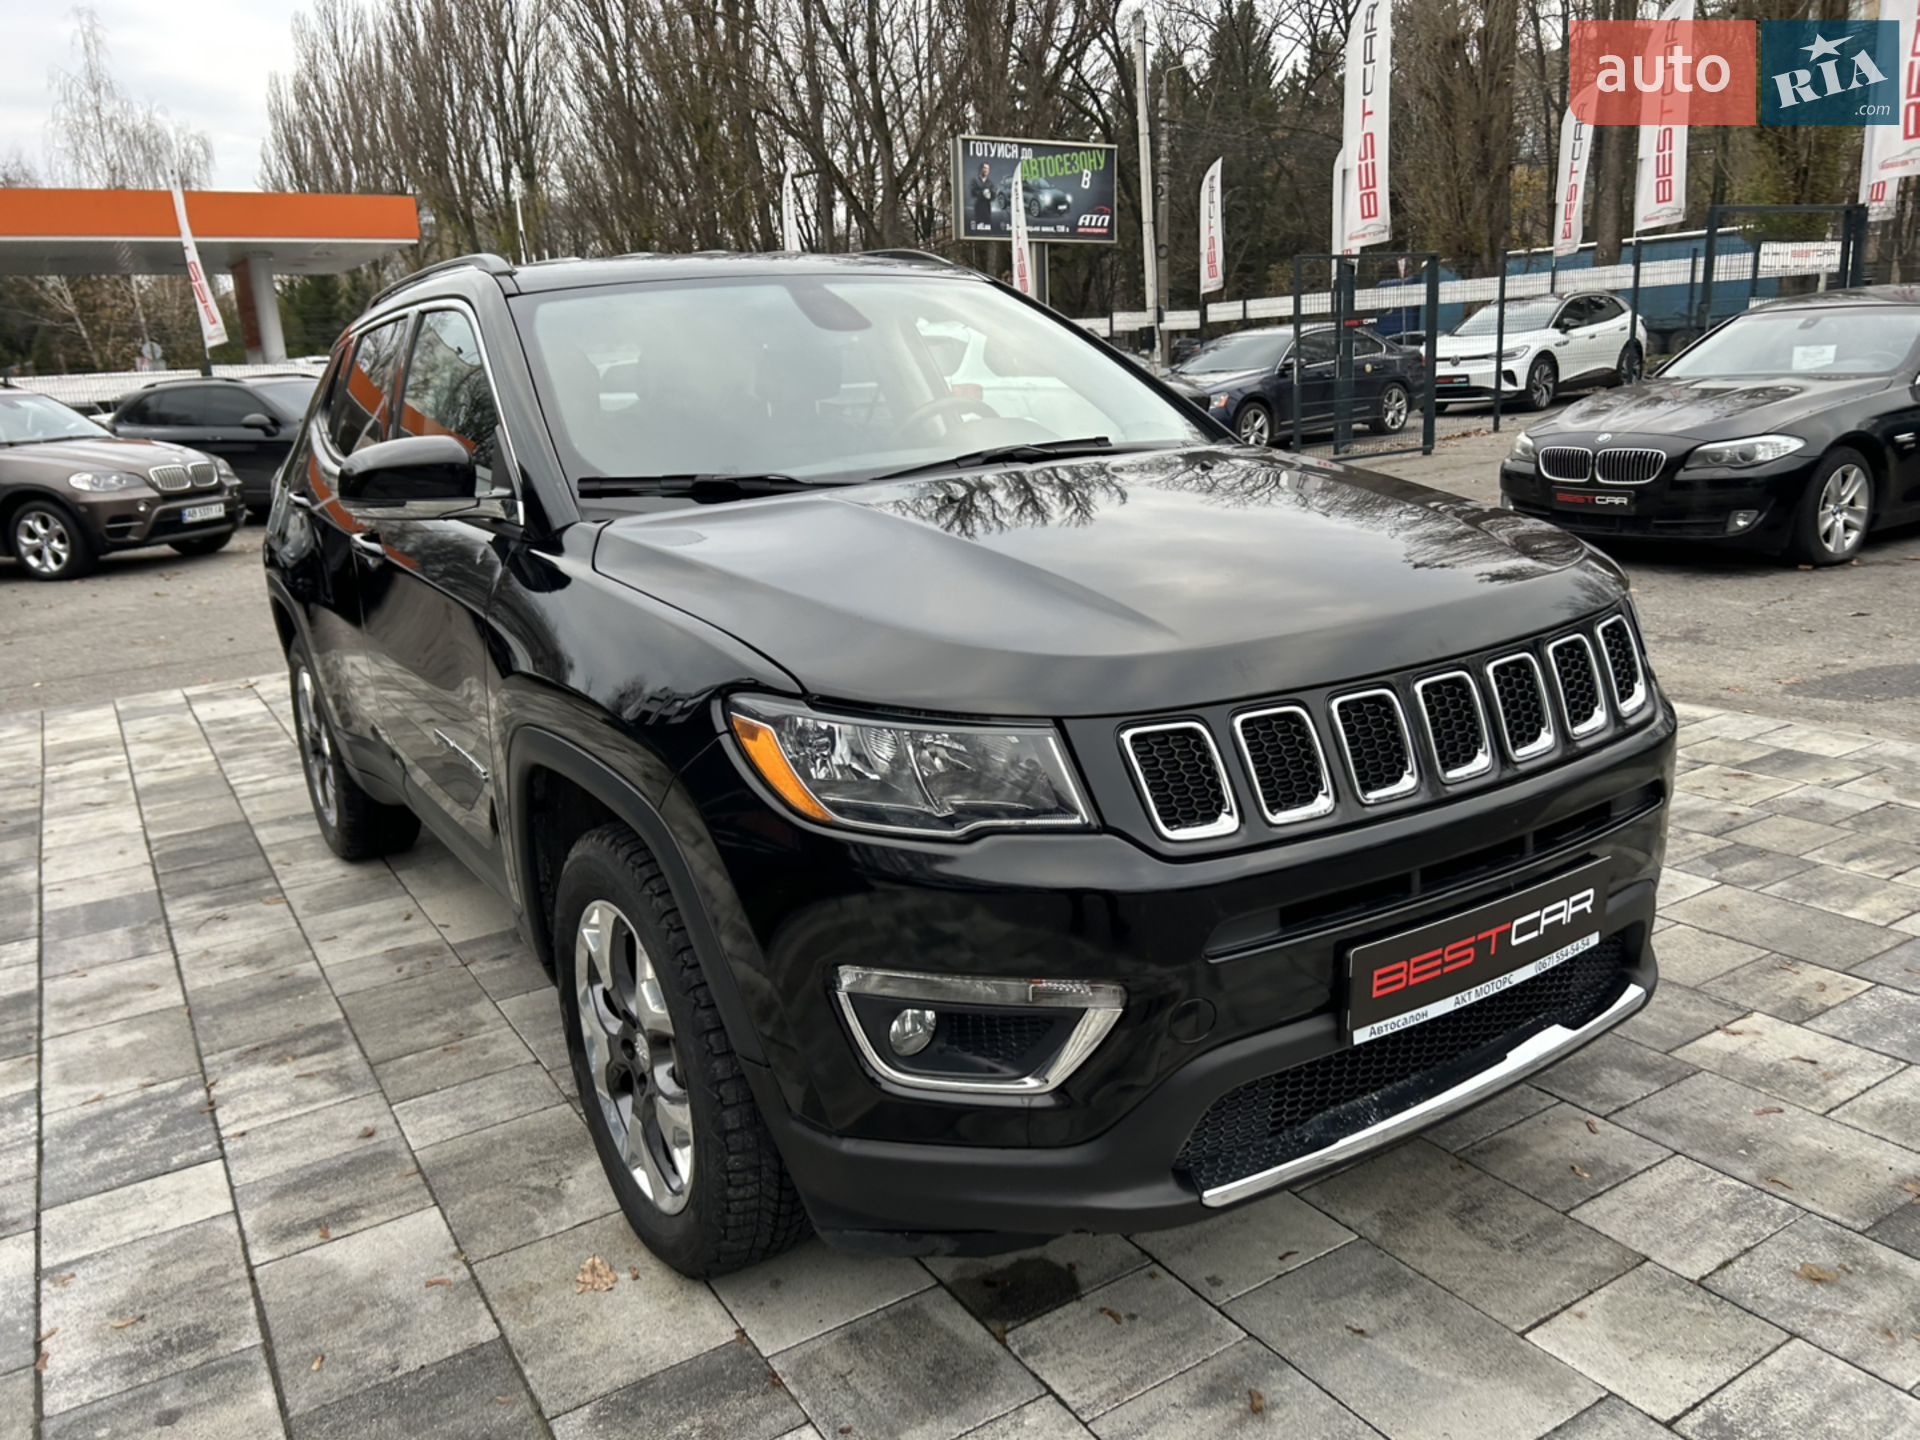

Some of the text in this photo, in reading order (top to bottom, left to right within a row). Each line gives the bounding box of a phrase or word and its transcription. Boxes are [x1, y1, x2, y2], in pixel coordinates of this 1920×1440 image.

[1358, 1, 1379, 219] BESTCAR
[1021, 149, 1106, 181] АВТОСЕЗОНУ
[1371, 887, 1595, 998] BESTCAR
[1534, 937, 1591, 974] (067) 554-54-54
[1453, 973, 1515, 1008] АКТ МОТОРС
[1369, 1010, 1429, 1038] Автосалон
